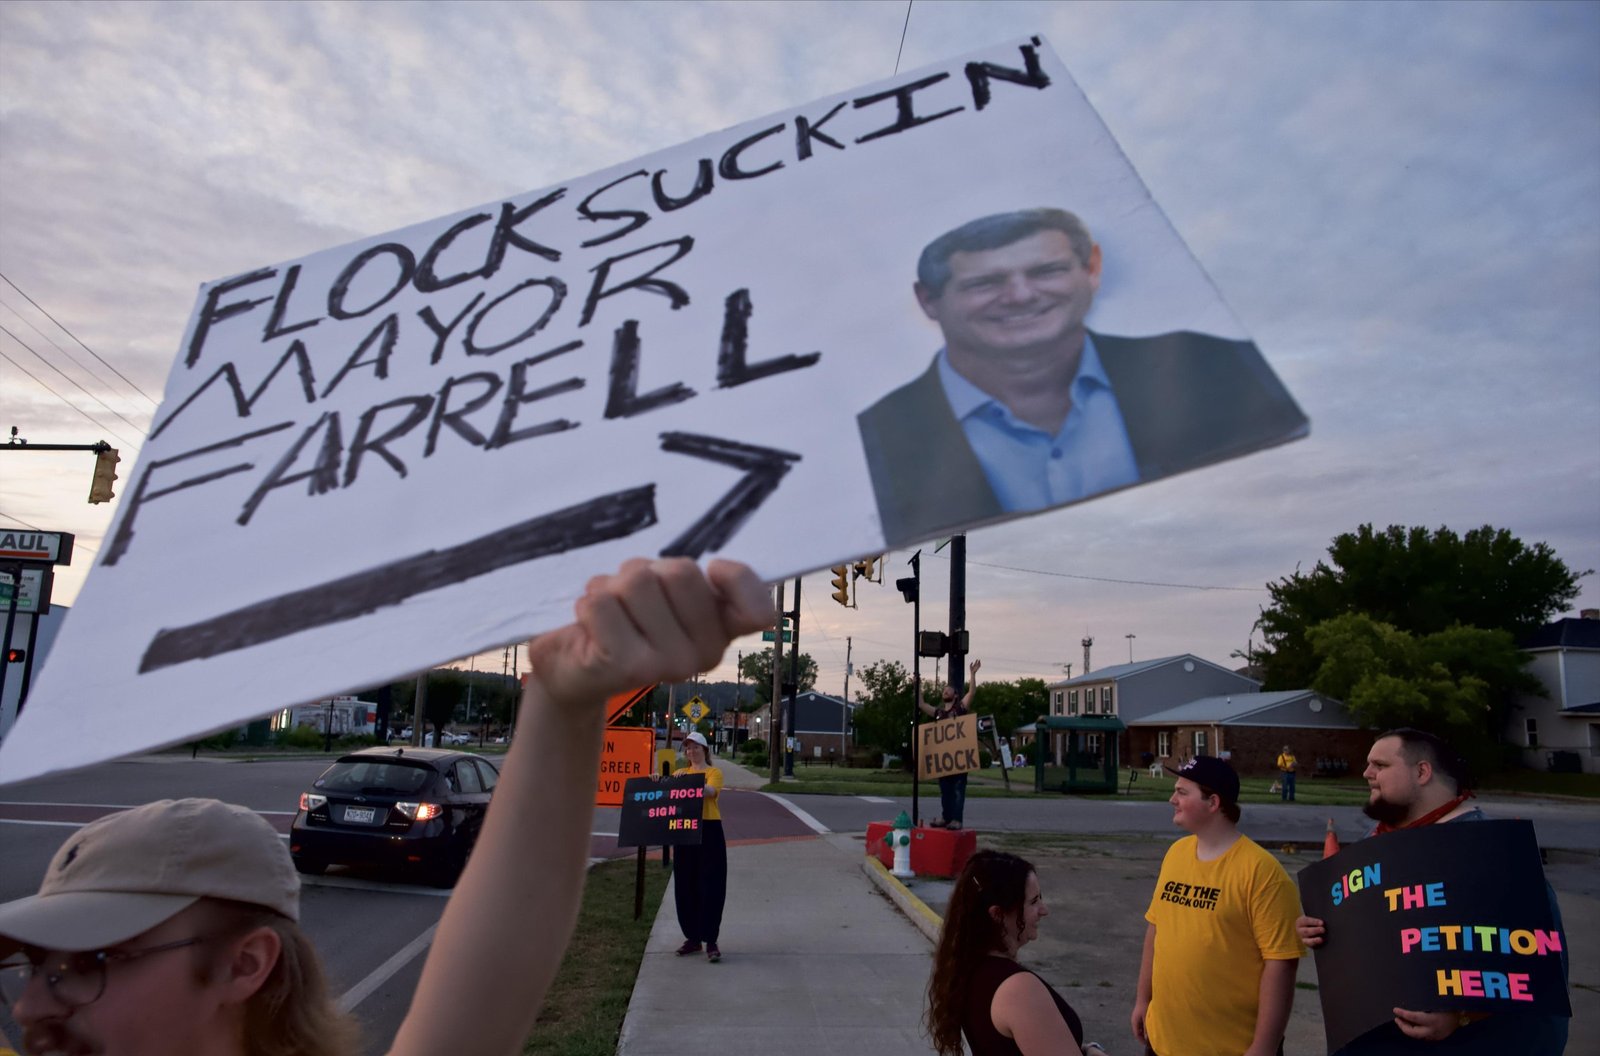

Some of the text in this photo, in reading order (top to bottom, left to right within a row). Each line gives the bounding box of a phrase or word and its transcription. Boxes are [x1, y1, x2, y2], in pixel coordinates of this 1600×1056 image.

[149, 235, 695, 441] MAYOR
[101, 287, 822, 566] FARRELL
[923, 721, 966, 746] FUCK
[600, 761, 640, 774] GREER
[925, 748, 978, 774] FLOCK
[634, 791, 663, 801] STOP
[648, 805, 677, 817] SIGN
[669, 819, 698, 830] HERE
[1164, 881, 1221, 901] GET THE
[1331, 863, 1381, 906] SIGN
[1384, 882, 1447, 912] THE
[1161, 892, 1216, 911] FLOCK OUT!
[1401, 925, 1562, 955] PETITION
[1437, 969, 1534, 1002] HERE
